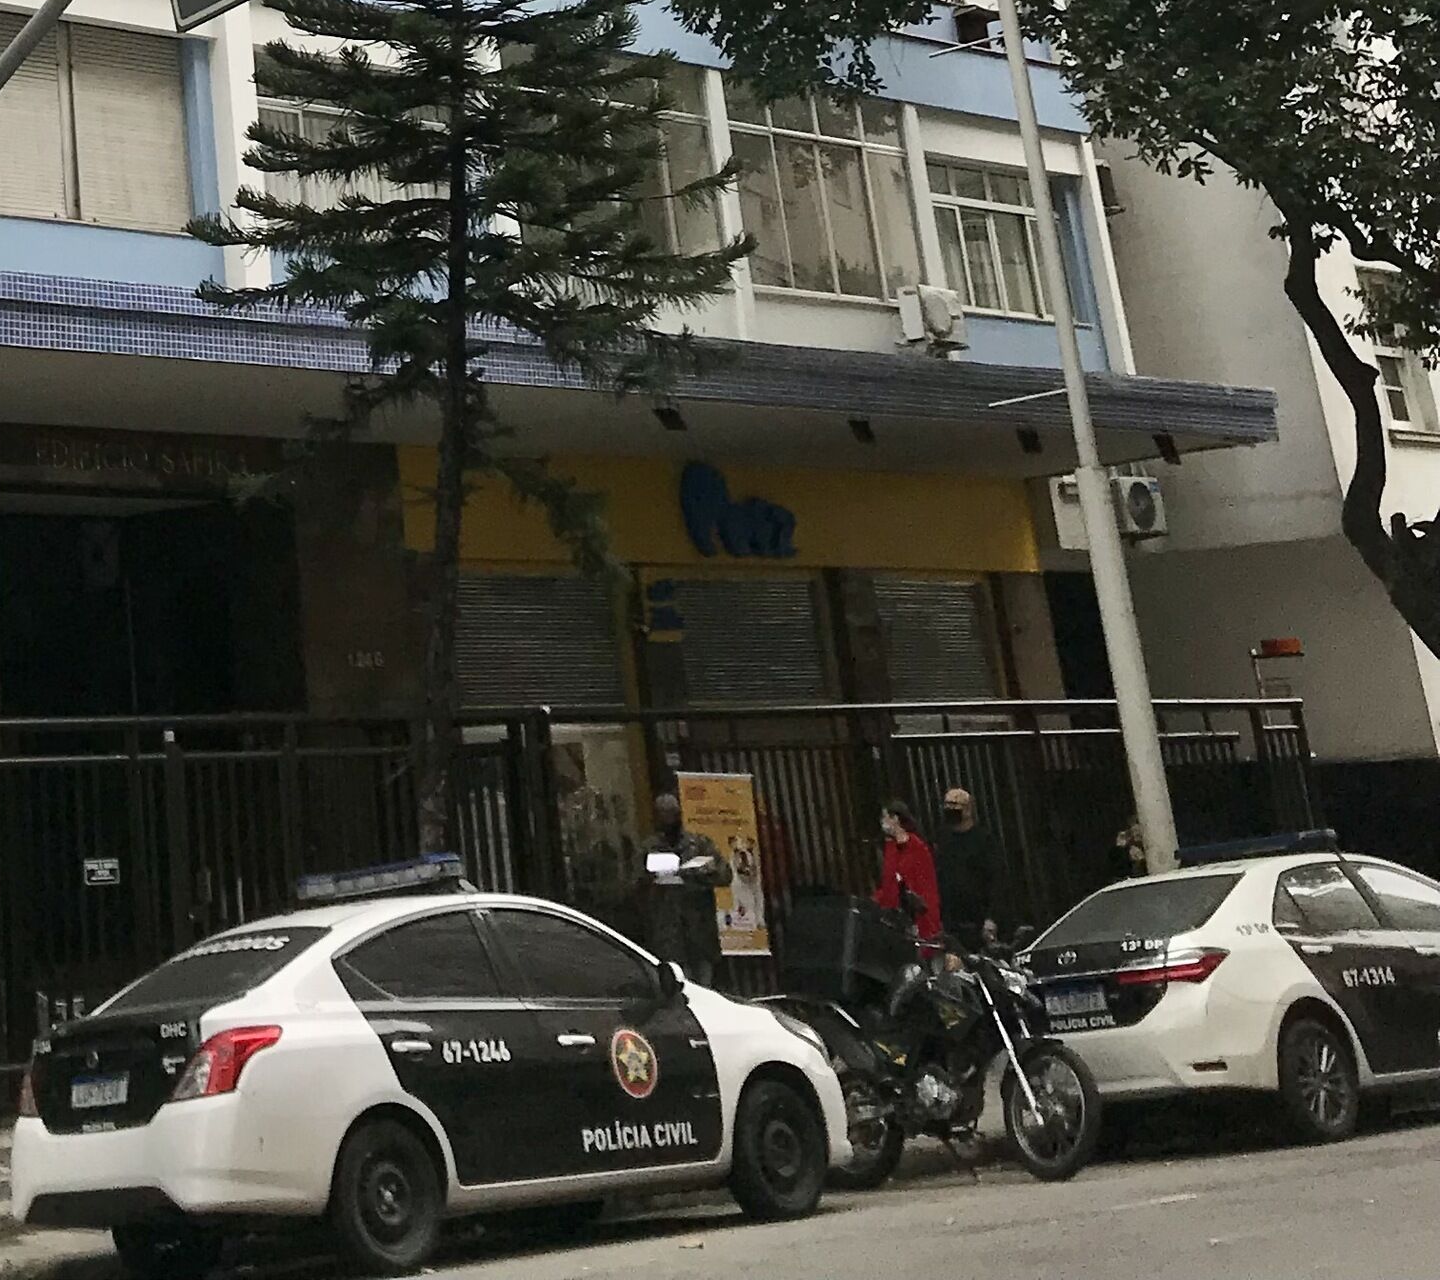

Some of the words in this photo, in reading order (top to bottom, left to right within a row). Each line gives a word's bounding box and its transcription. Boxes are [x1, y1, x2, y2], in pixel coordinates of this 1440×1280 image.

[1342, 966, 1396, 988] 67-1314
[441, 1040, 511, 1064] 67-1246
[581, 1120, 652, 1153] POLÍCIA
[653, 1121, 699, 1148] CIVIL
